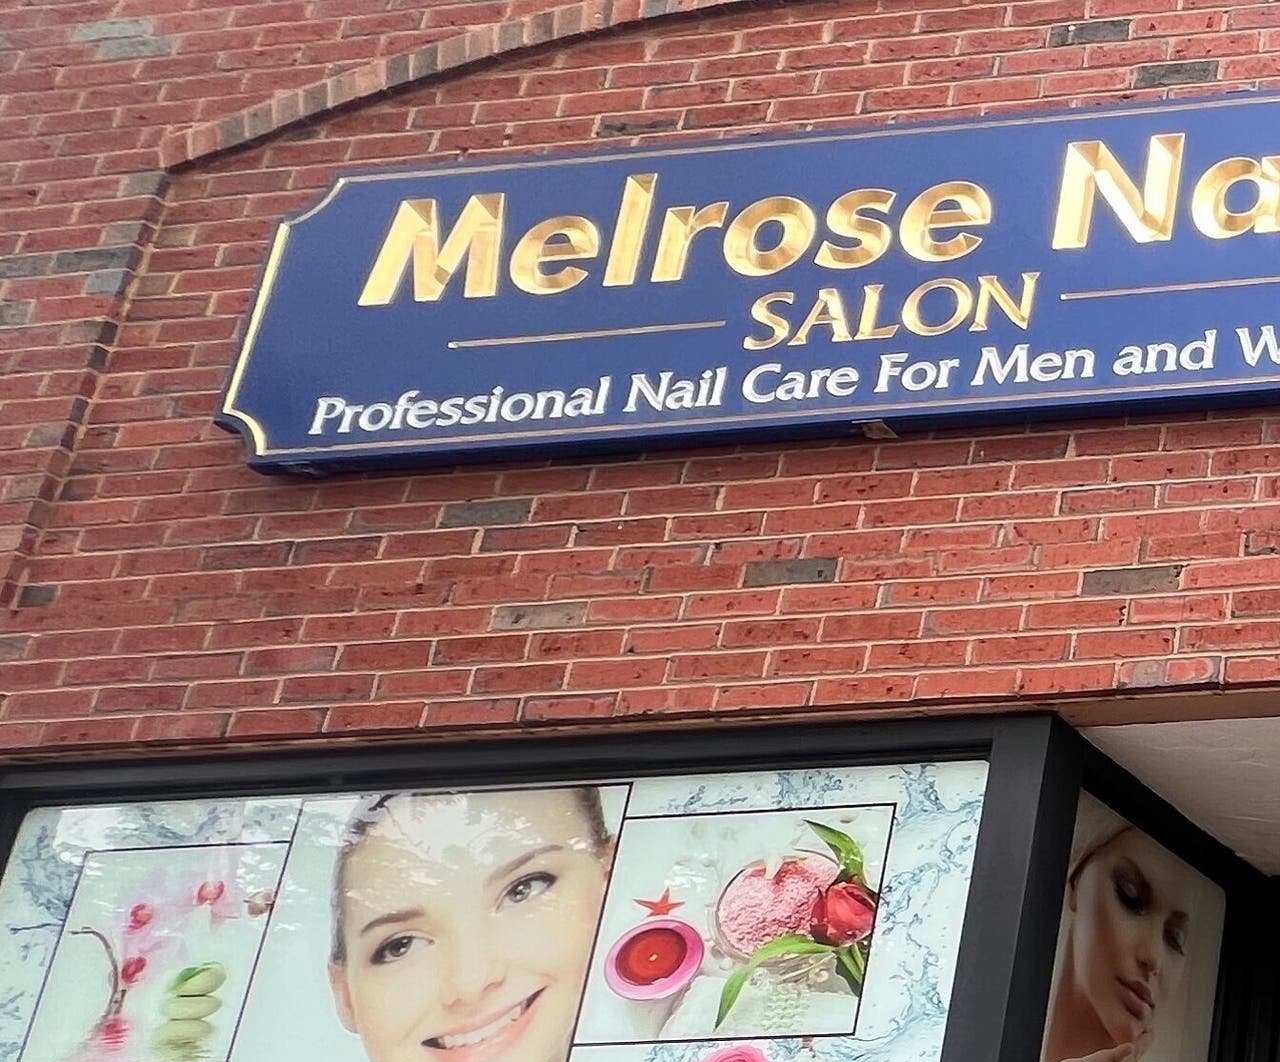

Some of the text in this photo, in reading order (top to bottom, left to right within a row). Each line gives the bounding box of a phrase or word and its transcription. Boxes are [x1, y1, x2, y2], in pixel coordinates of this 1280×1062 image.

[357, 173, 992, 306] Melrose
[743, 272, 1041, 350] SALON
[308, 374, 611, 436] Professional
[622, 366, 727, 413] Nail
[741, 363, 860, 404] Care
[873, 352, 960, 393] For
[971, 343, 1096, 387] Men
[1112, 329, 1218, 377] and
